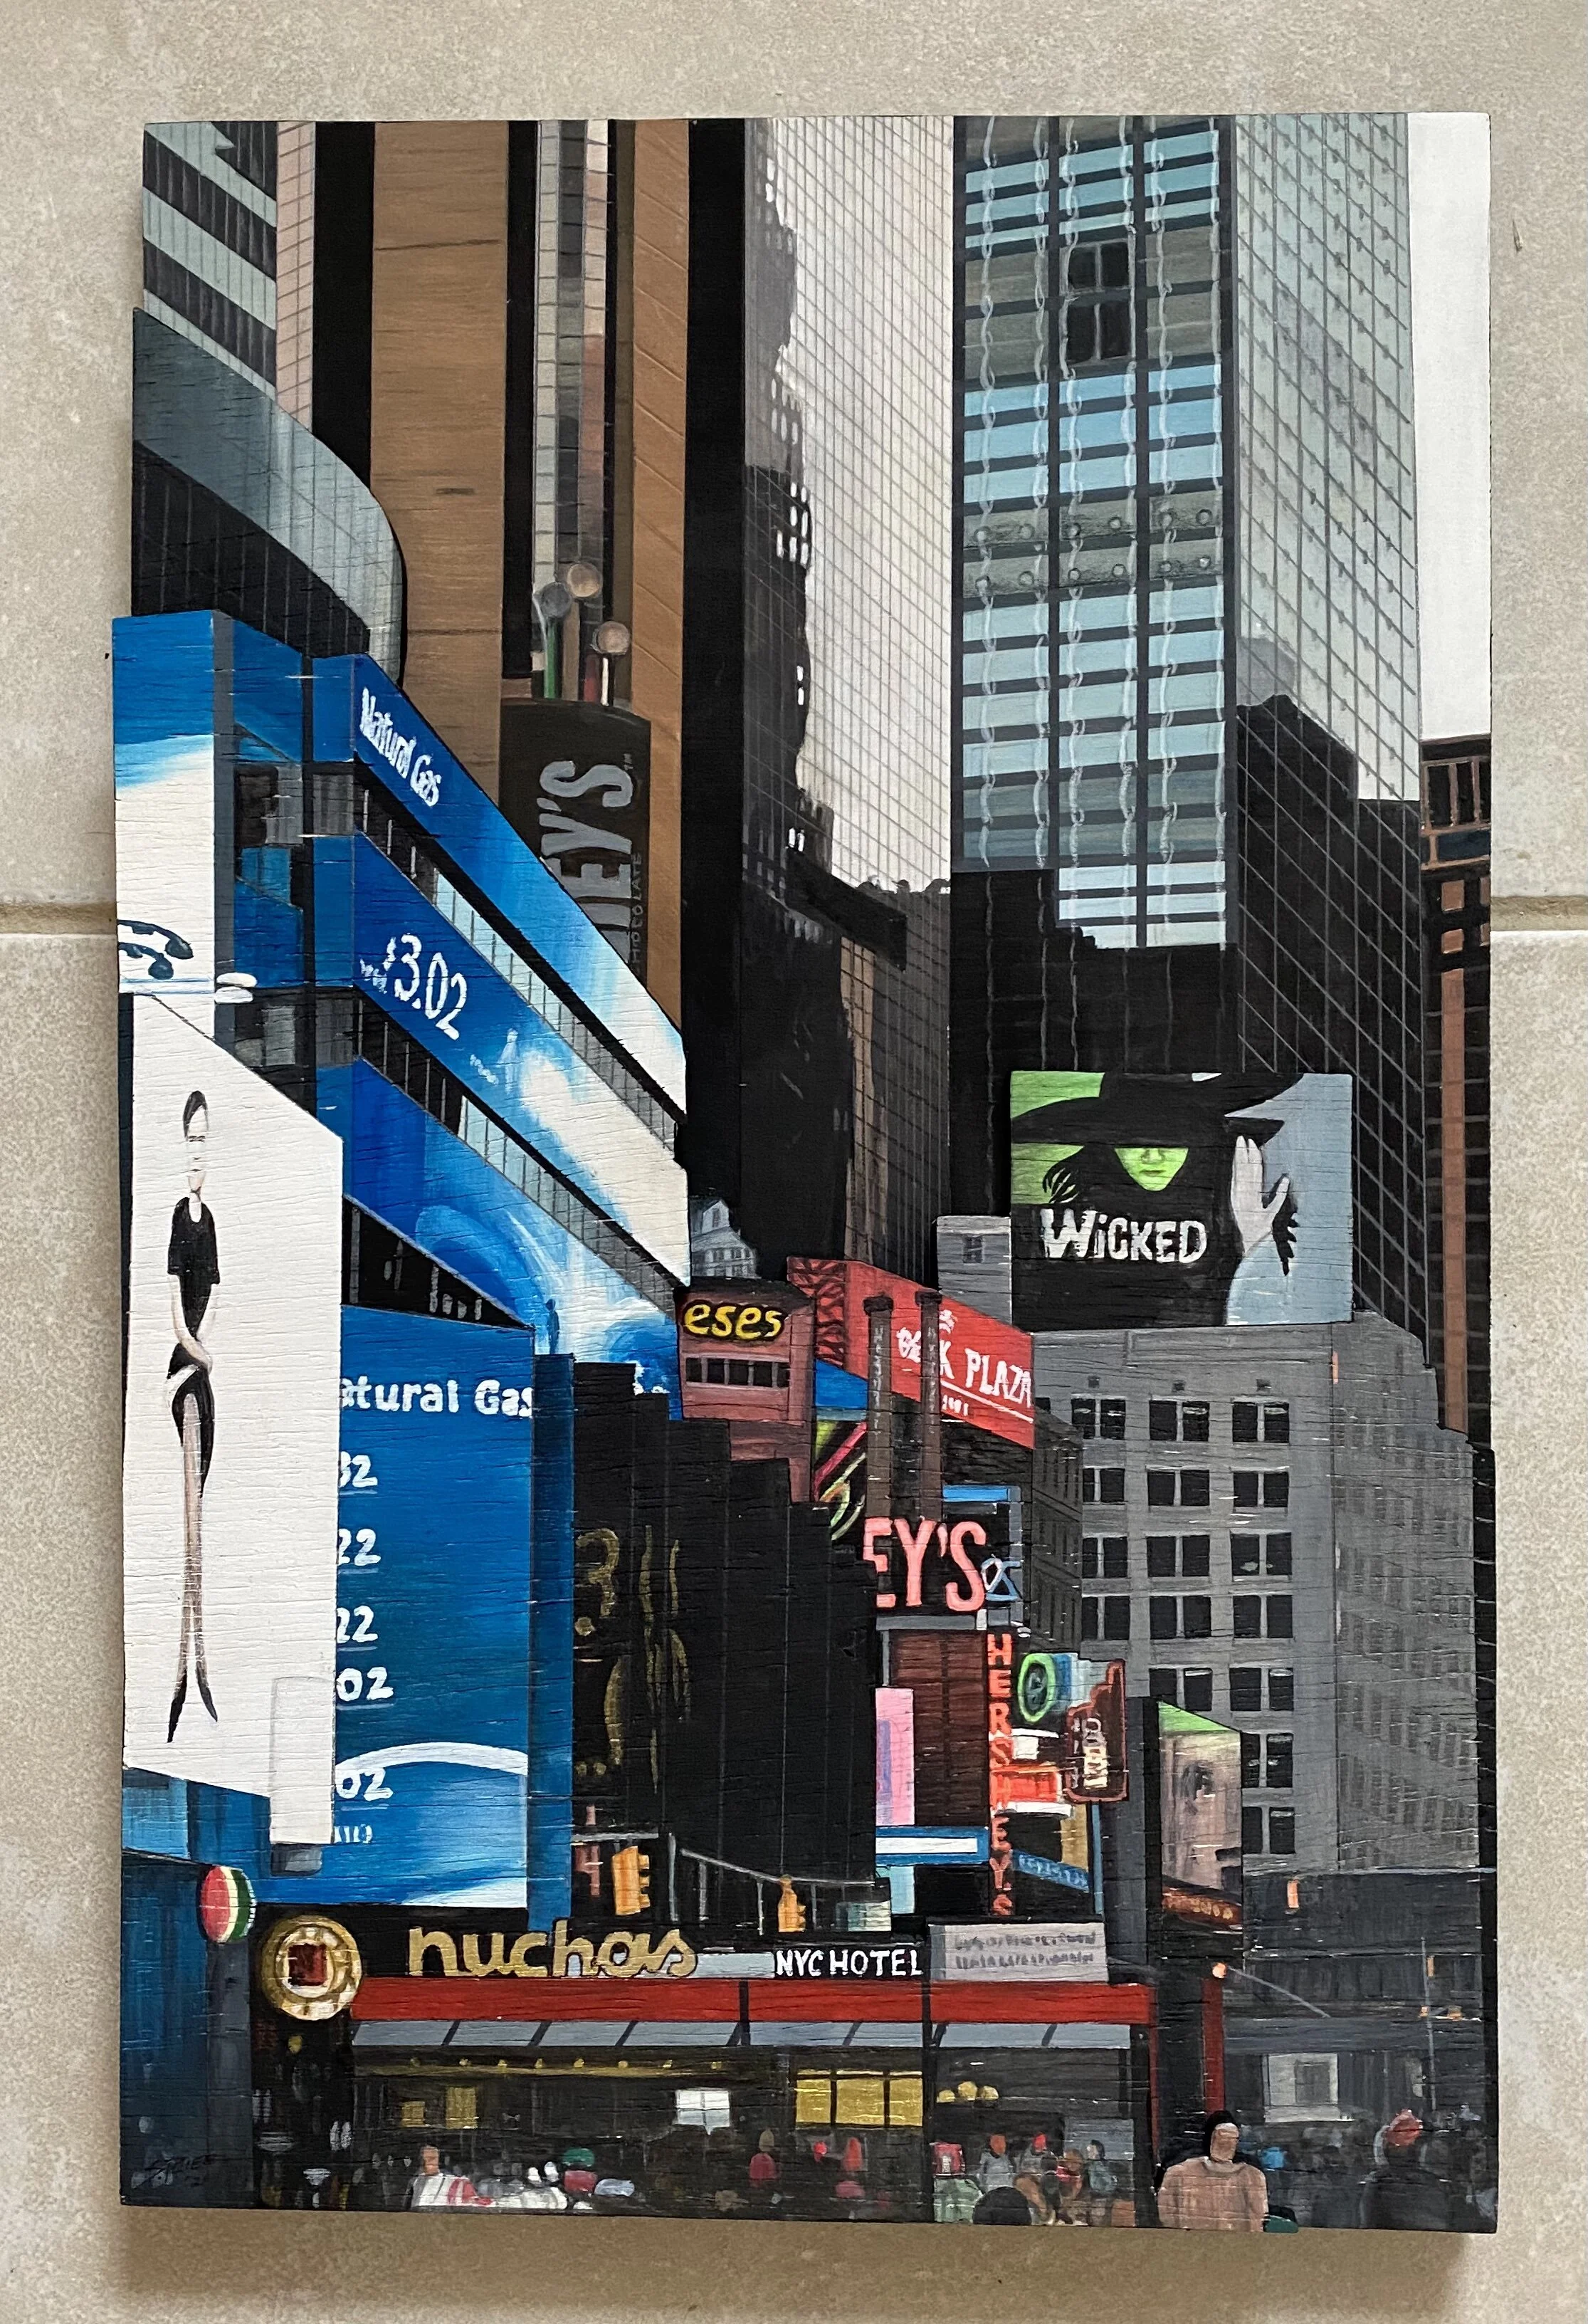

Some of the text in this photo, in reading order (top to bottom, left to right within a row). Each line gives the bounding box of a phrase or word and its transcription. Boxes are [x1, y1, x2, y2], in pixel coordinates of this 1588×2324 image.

[684, 1304, 782, 1340] eses
[964, 1347, 1032, 1408] PLAZA
[336, 1666, 394, 1702] 02
[408, 1920, 698, 1977] nuchas
[777, 1949, 824, 1977] NYC
[830, 1948, 925, 1977] HOTEL
